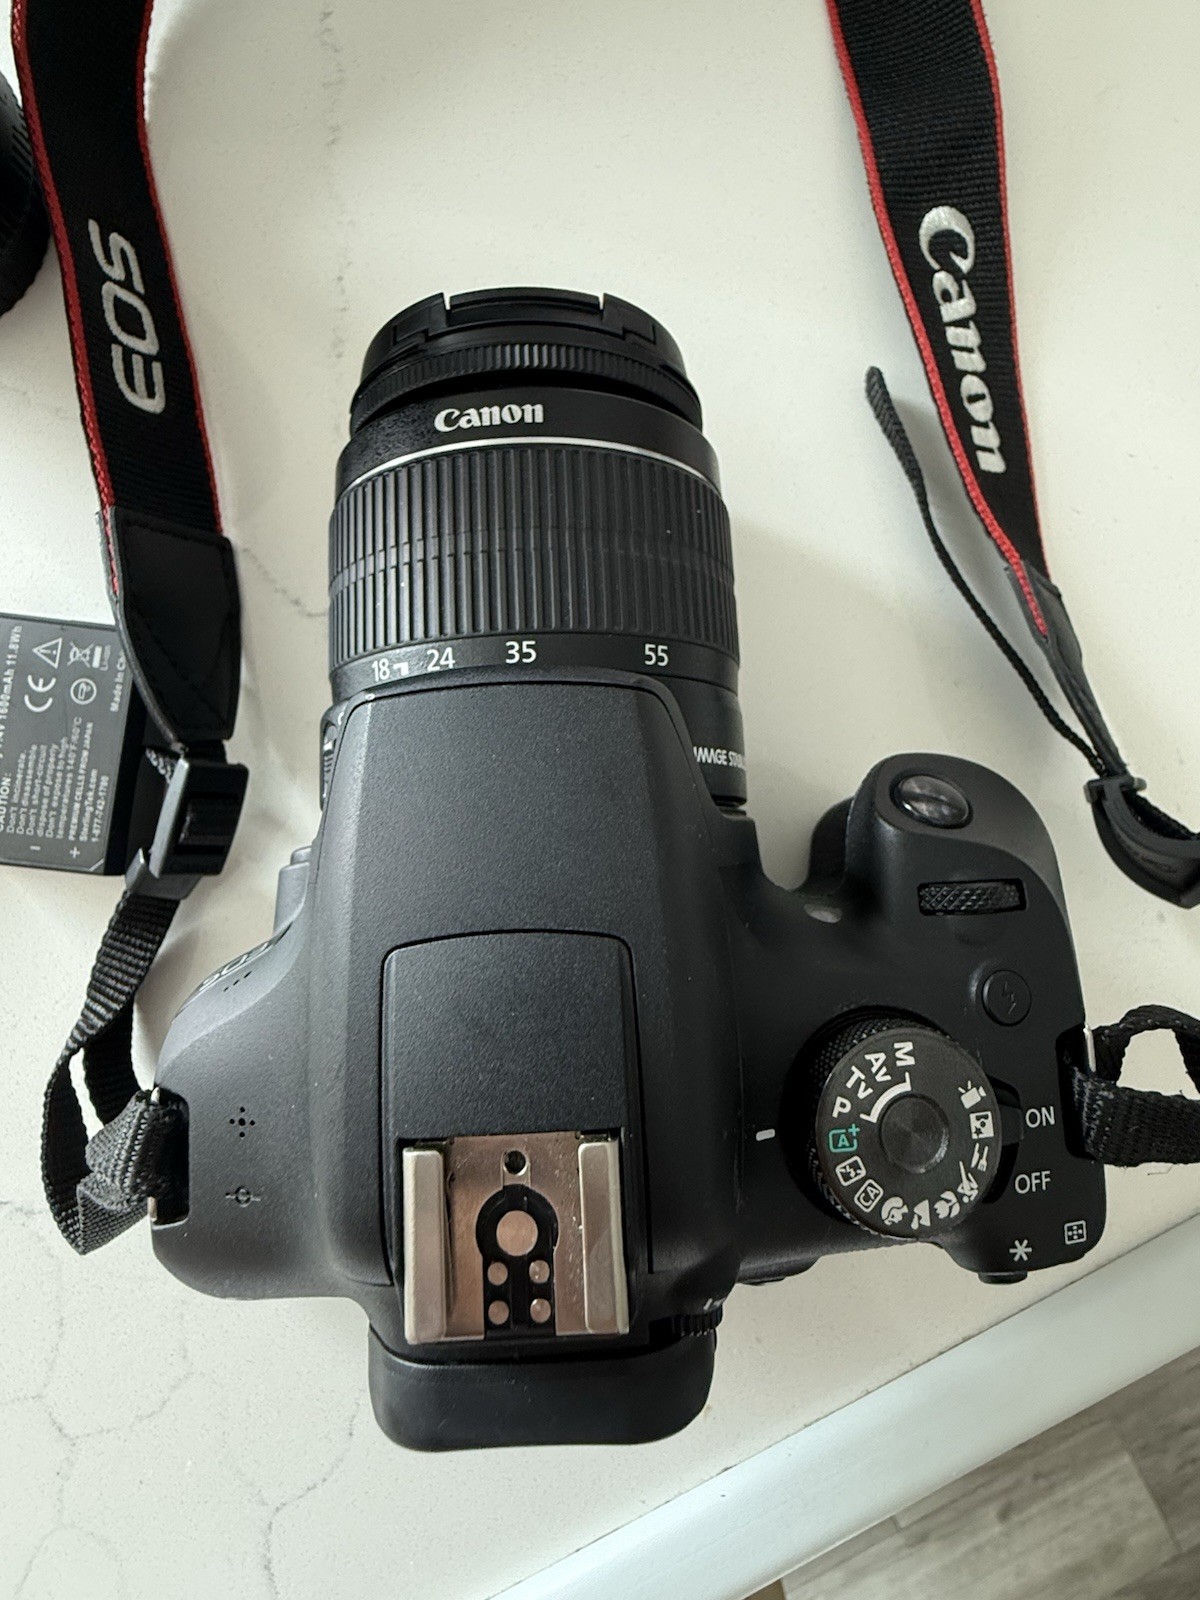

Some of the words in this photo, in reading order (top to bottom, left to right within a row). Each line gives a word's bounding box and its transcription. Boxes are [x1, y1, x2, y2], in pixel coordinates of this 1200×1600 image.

[88, 218, 166, 414] EOS
[919, 206, 1006, 473] Canon
[433, 403, 544, 433] Canon
[427, 647, 455, 672] 24
[505, 640, 537, 665] 35
[644, 644, 669, 667] 55
[372, 658, 391, 682] 18
[110, 684, 123, 712] Made
[83, 722, 93, 749] JAPAN
[57, 760, 65, 771] to
[78, 750, 89, 774] FROM
[693, 746, 727, 766] IMAGE
[42, 785, 51, 797] of
[74, 775, 85, 801] CELLS
[894, 1042, 915, 1067] M
[832, 1096, 851, 1118] P
[1025, 1106, 1056, 1129] ON
[1014, 1170, 1051, 1195] OFF
